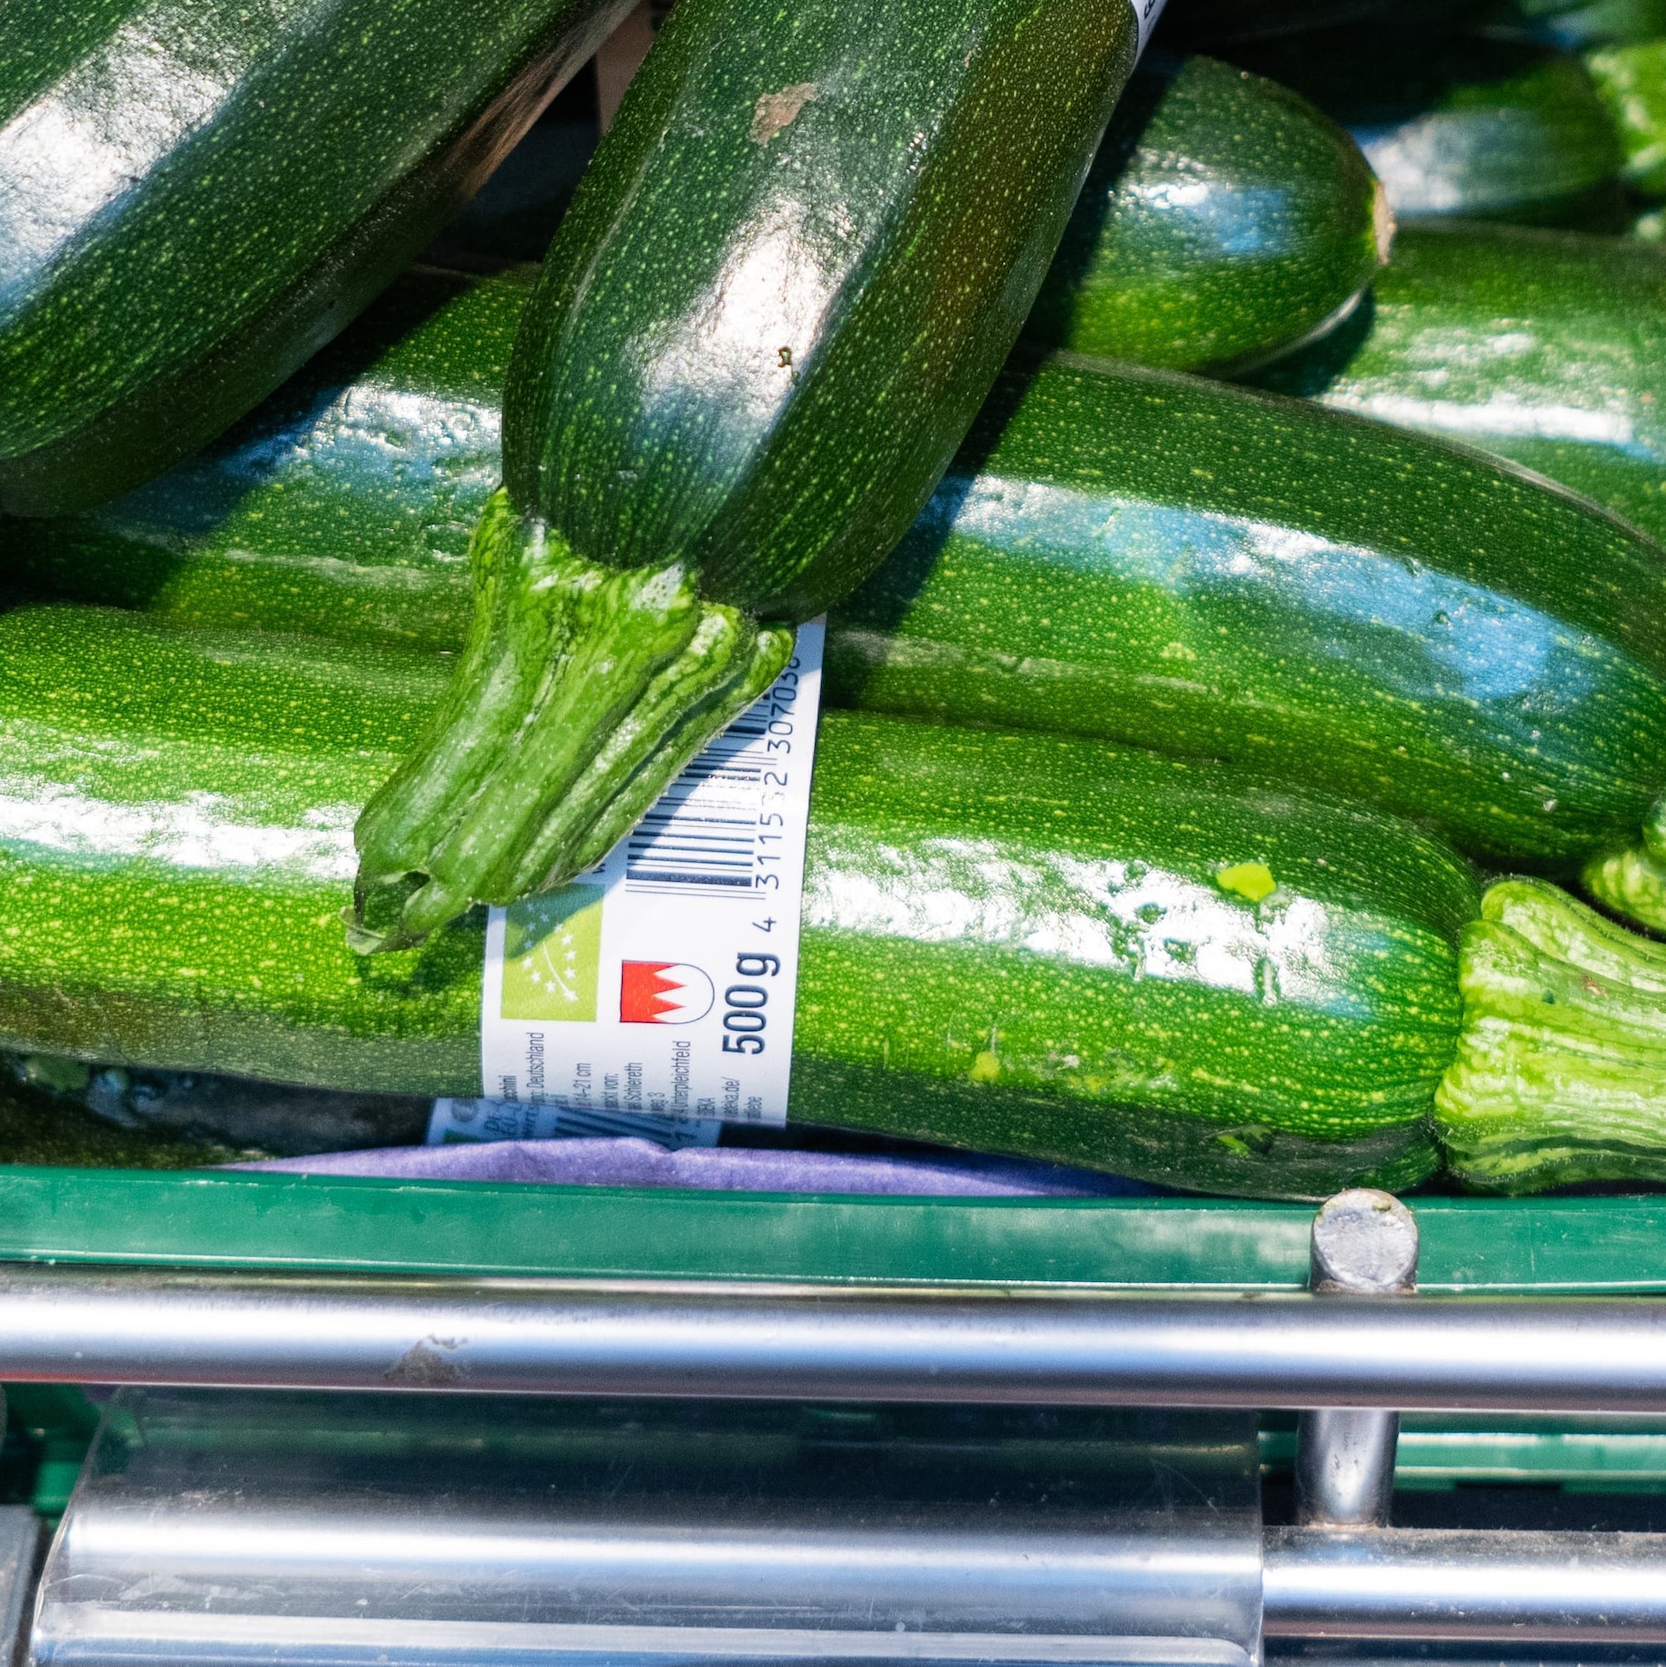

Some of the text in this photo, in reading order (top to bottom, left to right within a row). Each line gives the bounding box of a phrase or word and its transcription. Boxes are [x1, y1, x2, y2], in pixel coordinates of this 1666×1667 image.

[752, 916, 778, 934] 4
[722, 984, 769, 1056] 500
[525, 1031, 545, 1089] Deutschland
[623, 1062, 643, 1102] Schlereth
[670, 1040, 692, 1108] Unterpleichfeld
